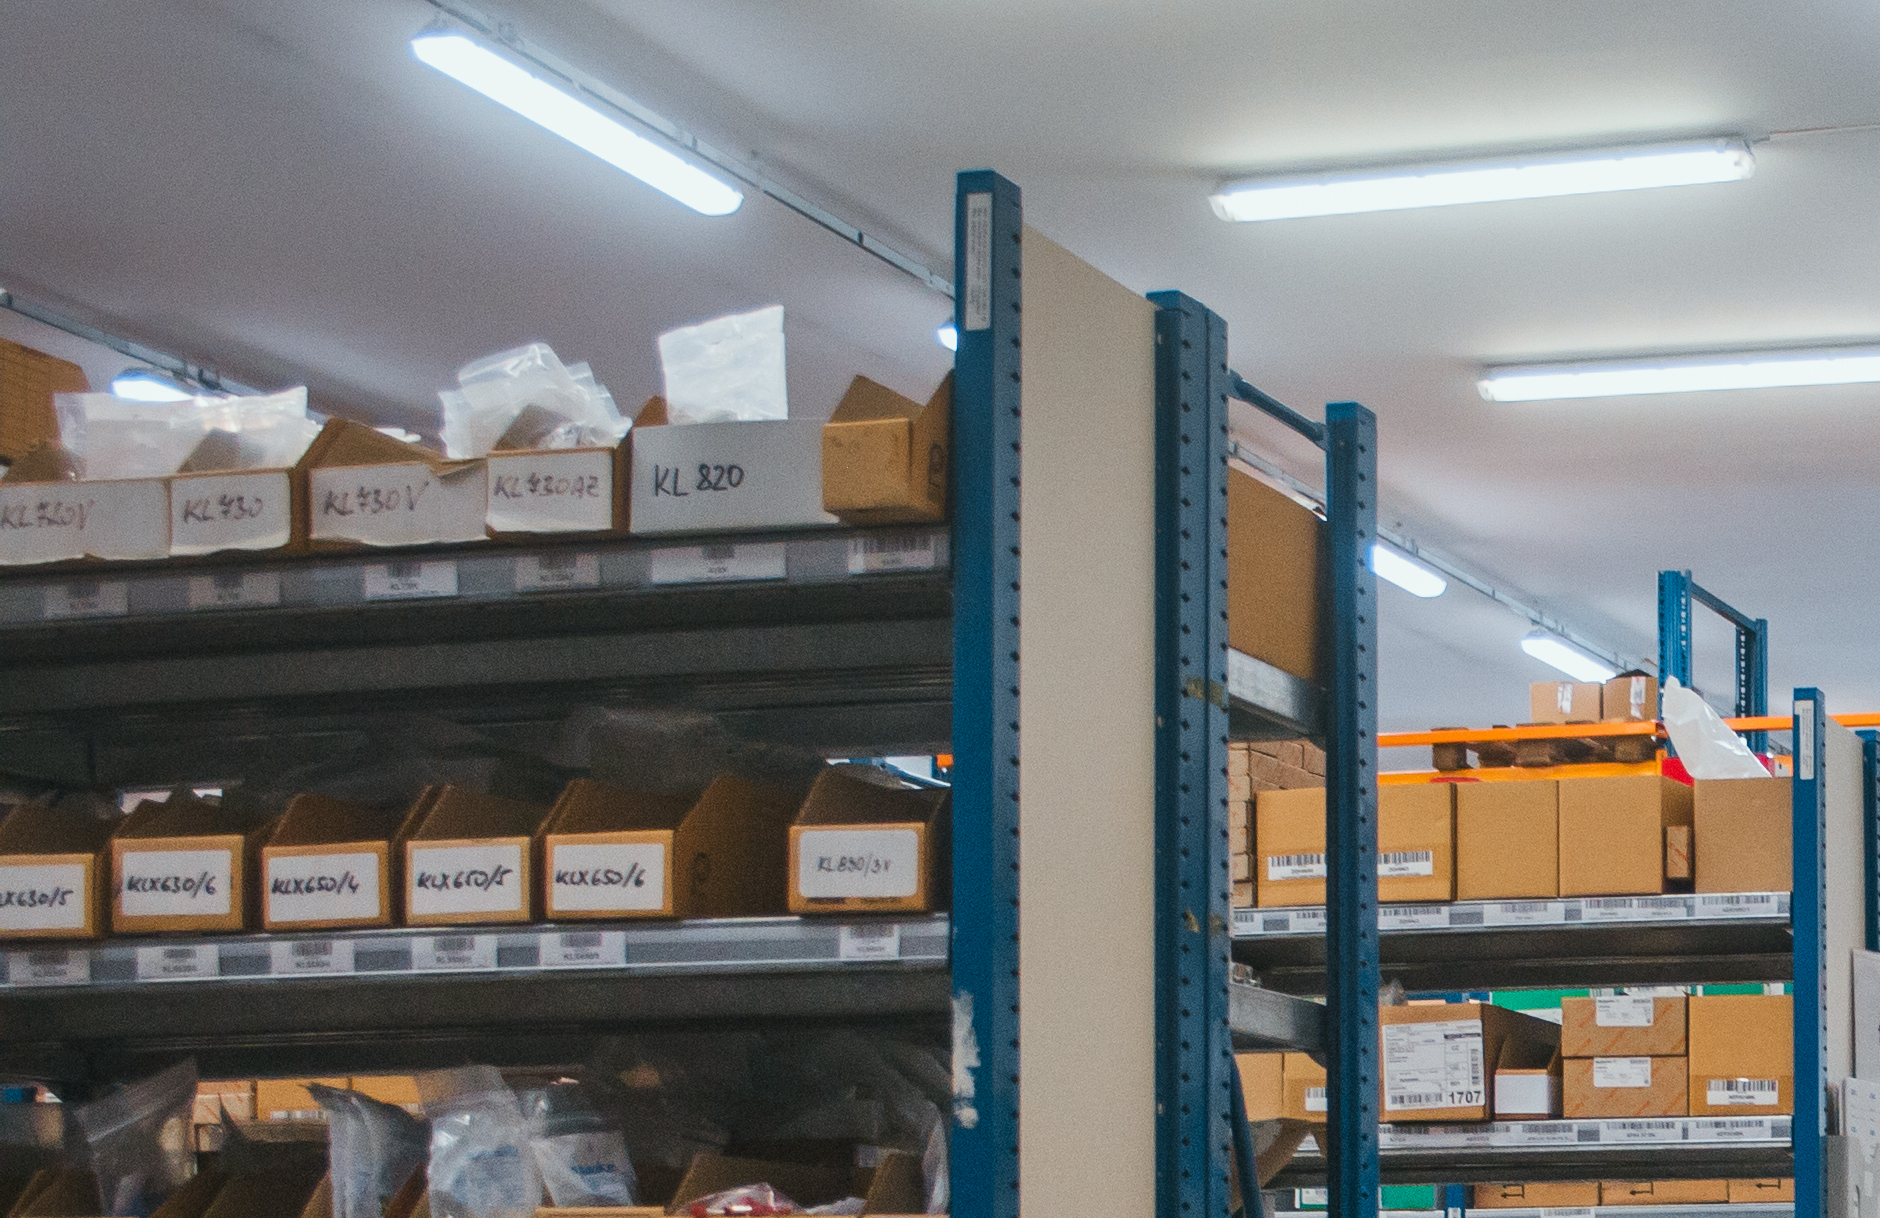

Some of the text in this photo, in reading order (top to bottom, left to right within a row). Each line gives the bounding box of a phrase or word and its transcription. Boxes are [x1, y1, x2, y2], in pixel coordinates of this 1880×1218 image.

[653, 463, 744, 498] KL 820
[1449, 1091, 1482, 1105] 1707
